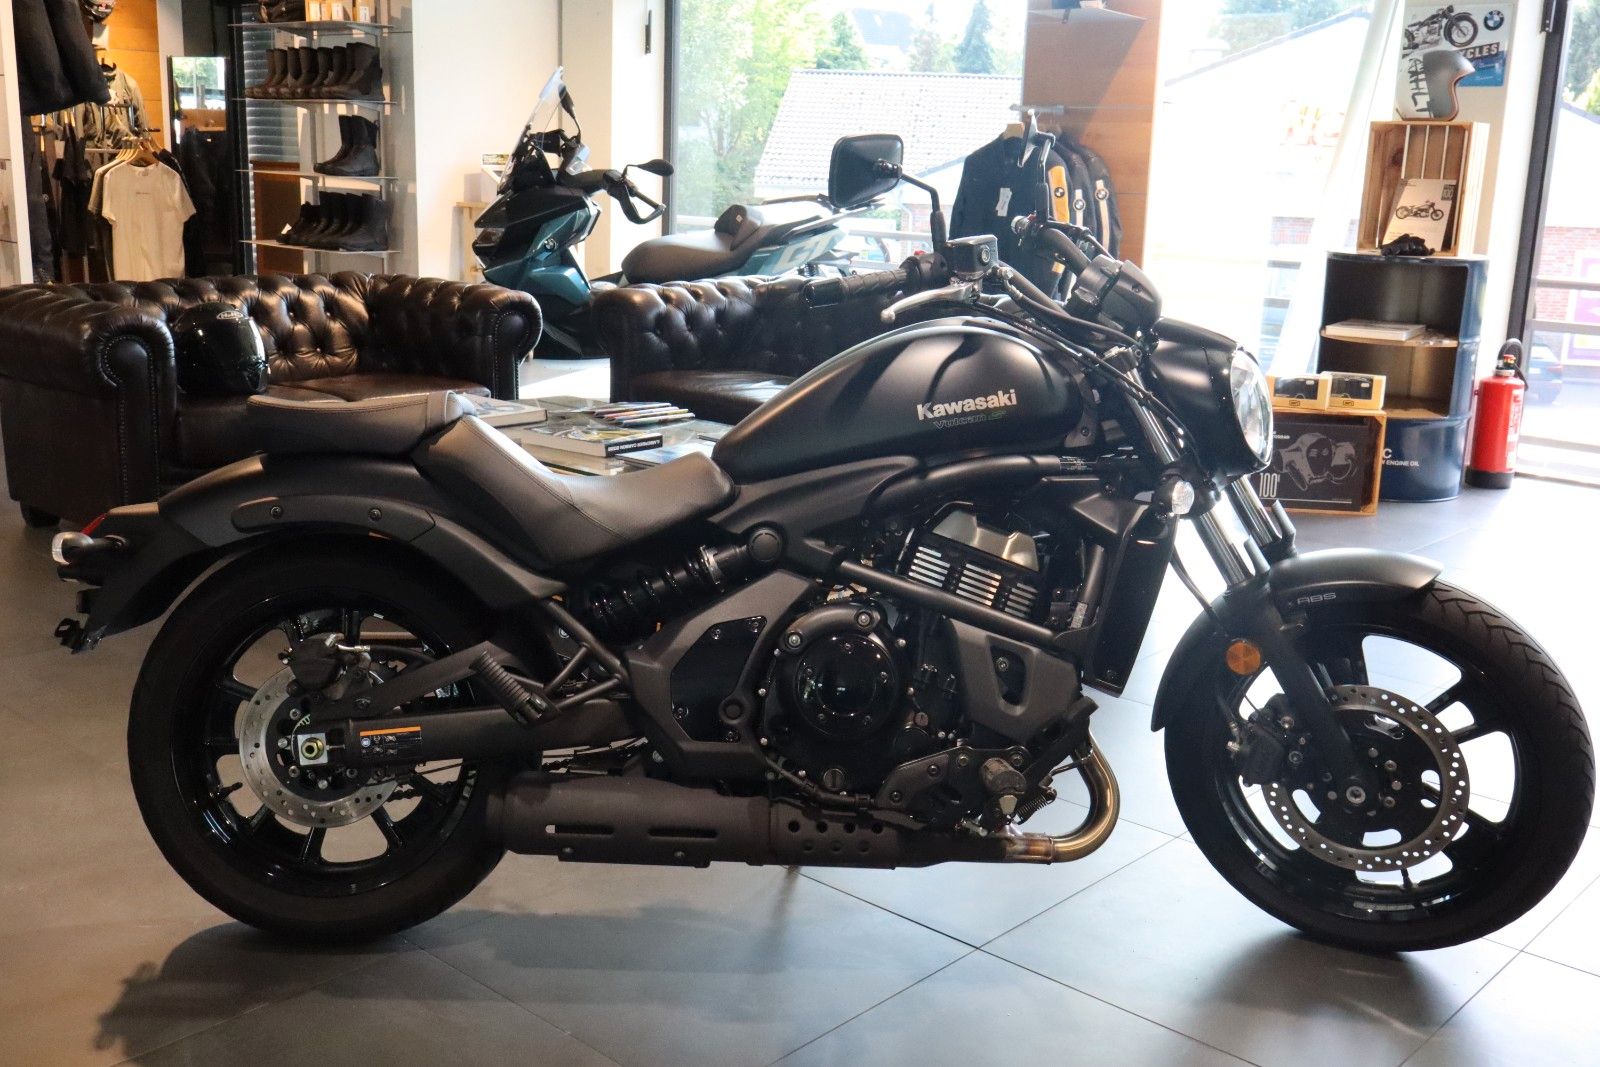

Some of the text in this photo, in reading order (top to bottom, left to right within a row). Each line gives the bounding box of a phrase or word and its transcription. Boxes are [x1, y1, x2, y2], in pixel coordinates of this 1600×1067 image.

[917, 389, 1017, 420] Kawasaki
[933, 413, 987, 429] Vulcan
[1259, 473, 1277, 497] 100
[1297, 592, 1337, 604] ABS
